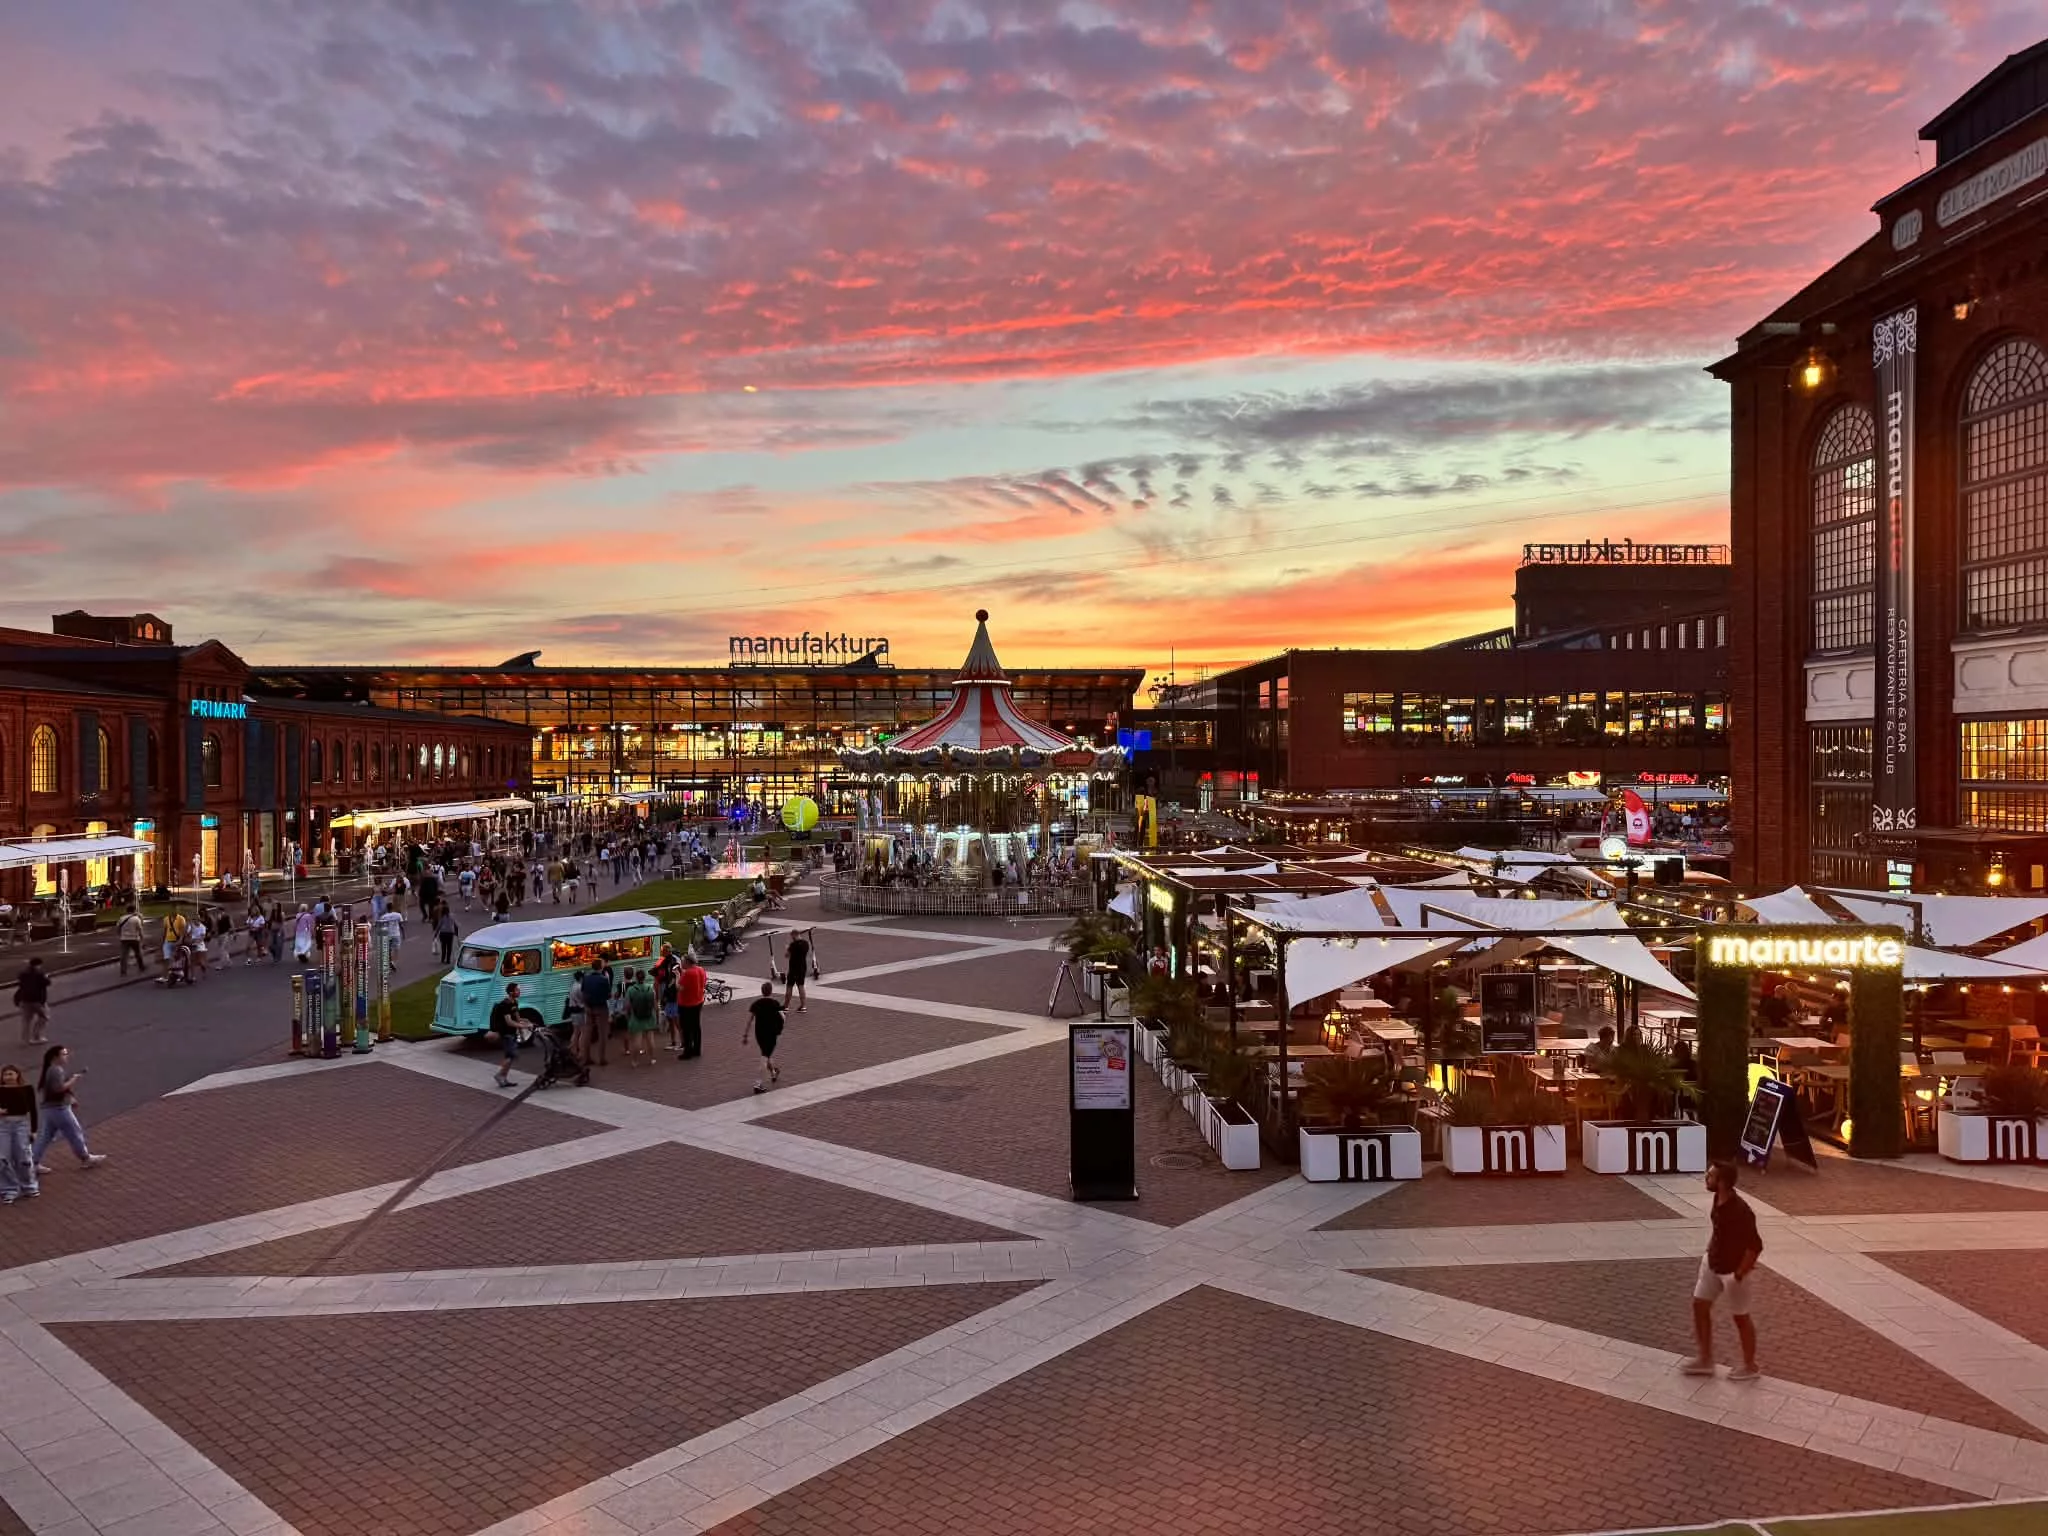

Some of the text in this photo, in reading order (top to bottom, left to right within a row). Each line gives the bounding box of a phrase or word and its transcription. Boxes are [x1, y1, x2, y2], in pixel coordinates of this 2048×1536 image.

[730, 631, 889, 654] manufaktura
[1886, 607, 1896, 716] RESTAURANTE
[1897, 618, 1909, 754] CAFETERIA & BAR
[190, 699, 247, 719] PRIMARK
[1885, 735, 1896, 776] CLUB
[1710, 937, 1904, 966] manuarte
[1346, 1138, 1384, 1178] m
[1490, 1130, 1528, 1172] m
[1635, 1131, 1672, 1172] m
[1994, 1118, 2030, 1161] m
